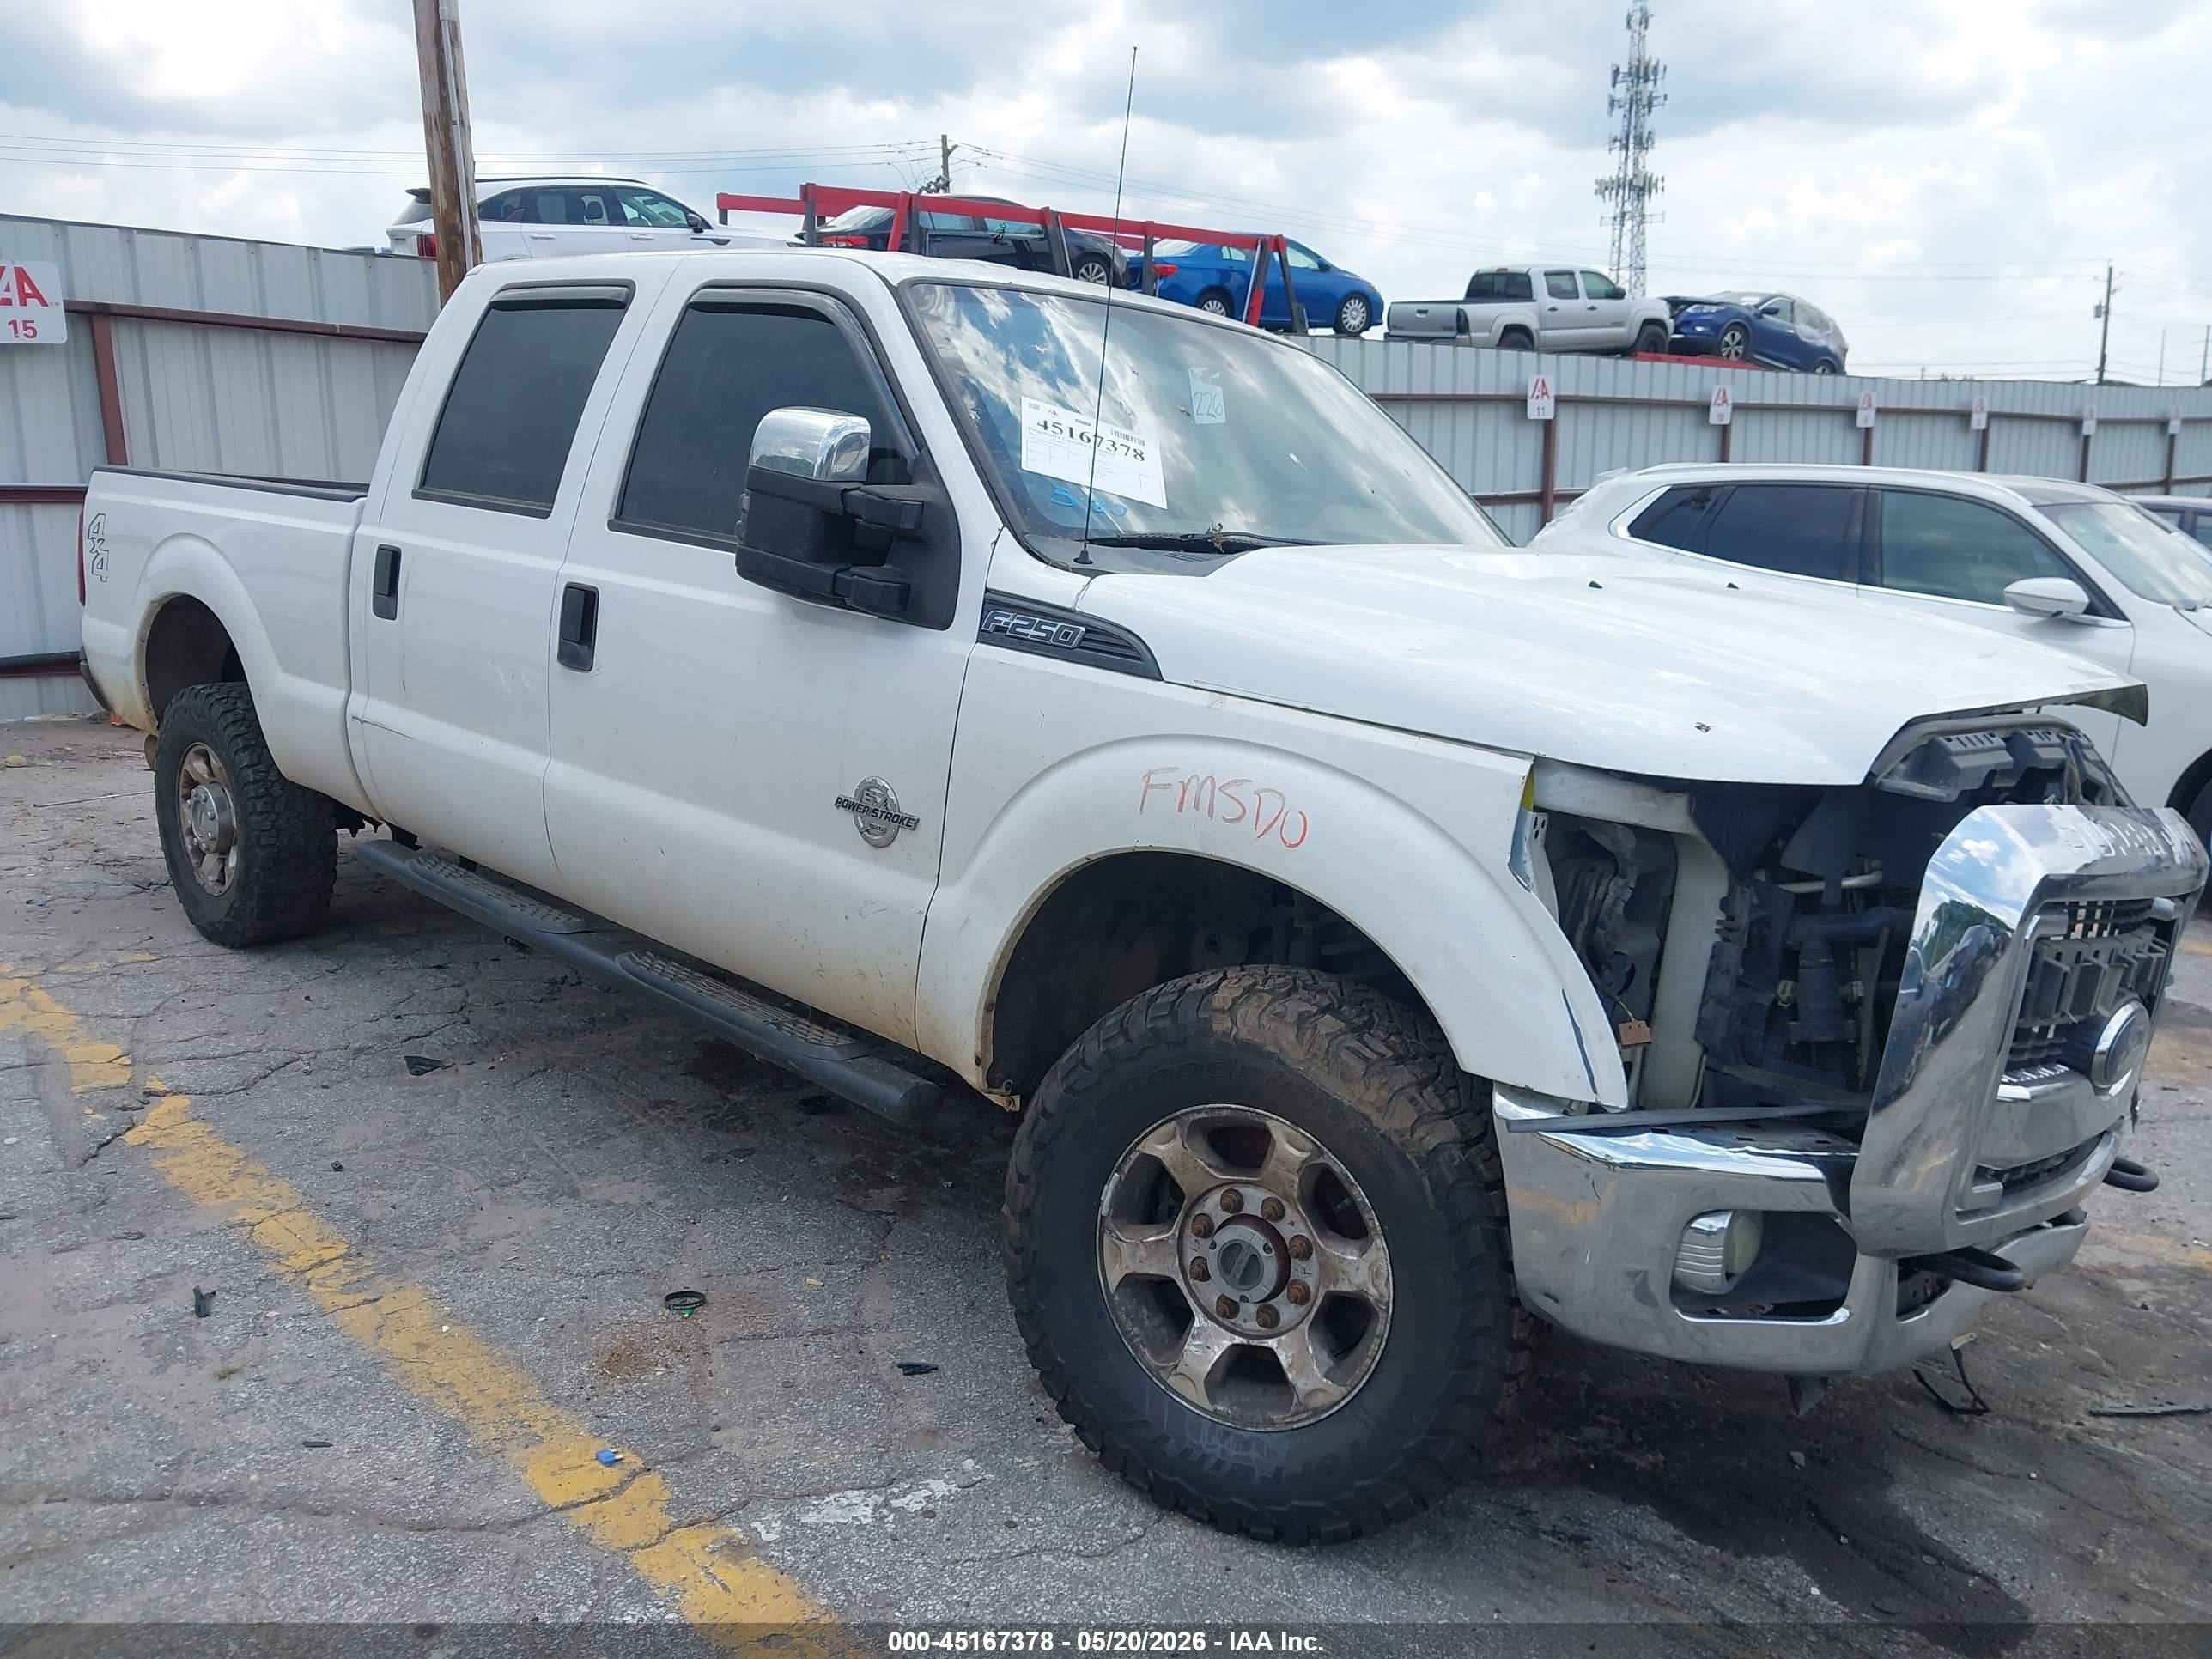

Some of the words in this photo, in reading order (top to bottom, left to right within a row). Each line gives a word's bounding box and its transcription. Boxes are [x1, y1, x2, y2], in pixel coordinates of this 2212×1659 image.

[8, 319, 37, 339] 15
[1193, 391, 1224, 417] 226
[1037, 420, 1146, 462] 45167378
